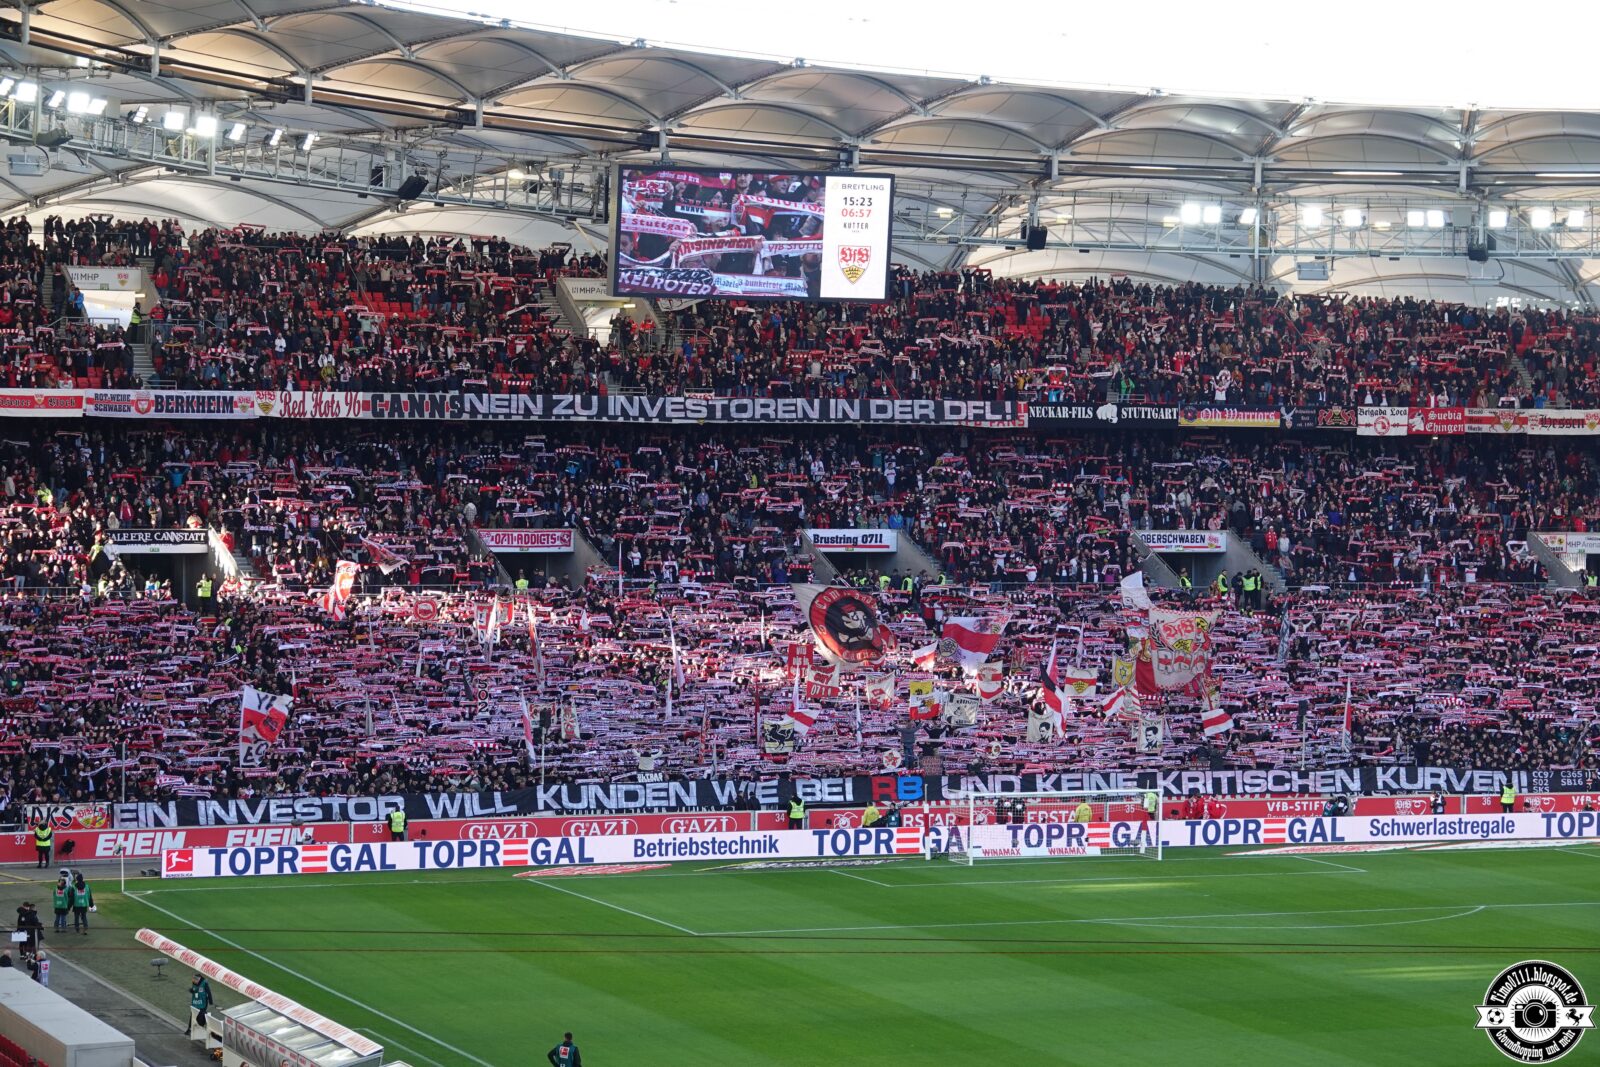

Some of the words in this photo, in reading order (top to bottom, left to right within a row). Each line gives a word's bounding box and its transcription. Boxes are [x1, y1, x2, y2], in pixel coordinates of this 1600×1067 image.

[841, 183, 885, 191] BREITLING
[842, 196, 873, 207] 15:23
[841, 208, 872, 218] 06:57
[632, 218, 689, 232] Stuttgar
[840, 247, 870, 263] VfB
[80, 273, 99, 281] MHP
[94, 404, 131, 412] SCHWABEN
[154, 395, 234, 413] BERKHEIM
[279, 392, 307, 417] Red
[310, 391, 341, 417] Hots
[344, 391, 361, 417] 96
[464, 394, 543, 416] NEIN
[552, 395, 601, 416] ZU
[608, 396, 827, 419] INVESTOREN
[830, 398, 860, 419] IN
[870, 399, 935, 420] DER
[943, 400, 1011, 420] DFL!
[1029, 405, 1093, 418] NECKAR-FILS
[1121, 406, 1178, 419] STUTTGART
[1200, 407, 1222, 422] Old
[1223, 408, 1276, 422] Warriors
[1358, 407, 1387, 417] Brigada
[1427, 411, 1462, 420] Suebia
[1425, 422, 1464, 433] Ehingen
[1540, 414, 1584, 430] Hessen
[154, 531, 206, 542] CANNSTATT
[516, 533, 557, 545] ADDICTS
[812, 533, 858, 546] Brustring
[861, 533, 883, 544] 0711
[1141, 534, 1206, 544] OBERSCHWABEN
[1532, 771, 1554, 779] CC97
[1532, 778, 1549, 786] S02
[1561, 778, 1584, 786] SB16
[113, 801, 177, 828] EIN
[197, 795, 405, 826] INVESTOR
[424, 791, 517, 819] WILL
[535, 780, 697, 812] KUNDEN
[711, 779, 779, 808] WIE
[795, 775, 854, 803] BEI
[871, 775, 923, 802] RB
[941, 773, 1021, 797] UND
[1035, 771, 1139, 793] KEINE
[1158, 768, 1361, 795] KRITISCHEN
[1376, 765, 1528, 793] KURVEN!
[1482, 797, 1491, 805] 36
[1125, 804, 1135, 813] 35
[775, 813, 785, 822] 34
[372, 823, 383, 834] 33
[15, 835, 26, 845] 32
[226, 827, 314, 848] EHEIM
[95, 831, 187, 857] EHEIM
[209, 843, 396, 877] TOPREGAL
[413, 837, 595, 869] TOPREGAL
[633, 834, 780, 858] Betriebstechnik
[1185, 817, 1345, 846] TOPREGAL
[1369, 816, 1515, 839] Schwerlastregale
[1541, 812, 1600, 838] TOP
[982, 848, 1021, 857] WINAMAX
[1048, 847, 1087, 855] WINAMAX
